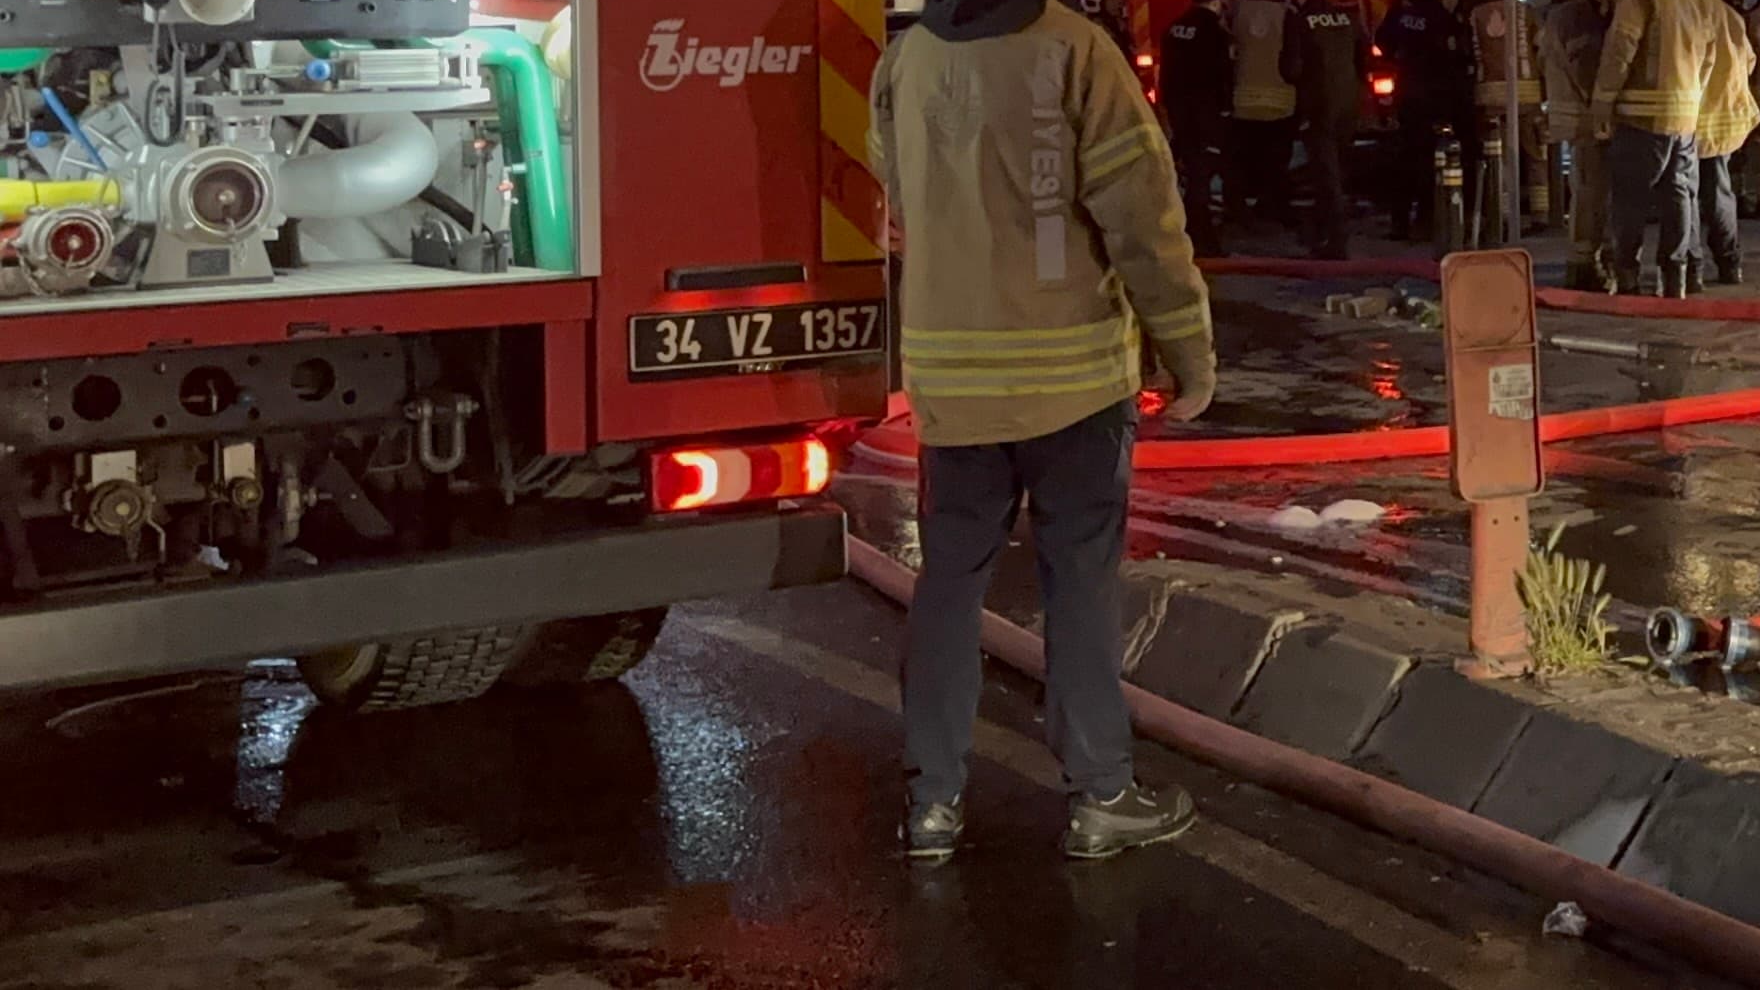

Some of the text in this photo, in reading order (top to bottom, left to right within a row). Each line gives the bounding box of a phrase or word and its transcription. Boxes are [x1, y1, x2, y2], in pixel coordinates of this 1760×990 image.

[639, 18, 812, 91] Ziegler
[656, 305, 878, 363] 34 VZ 1357
